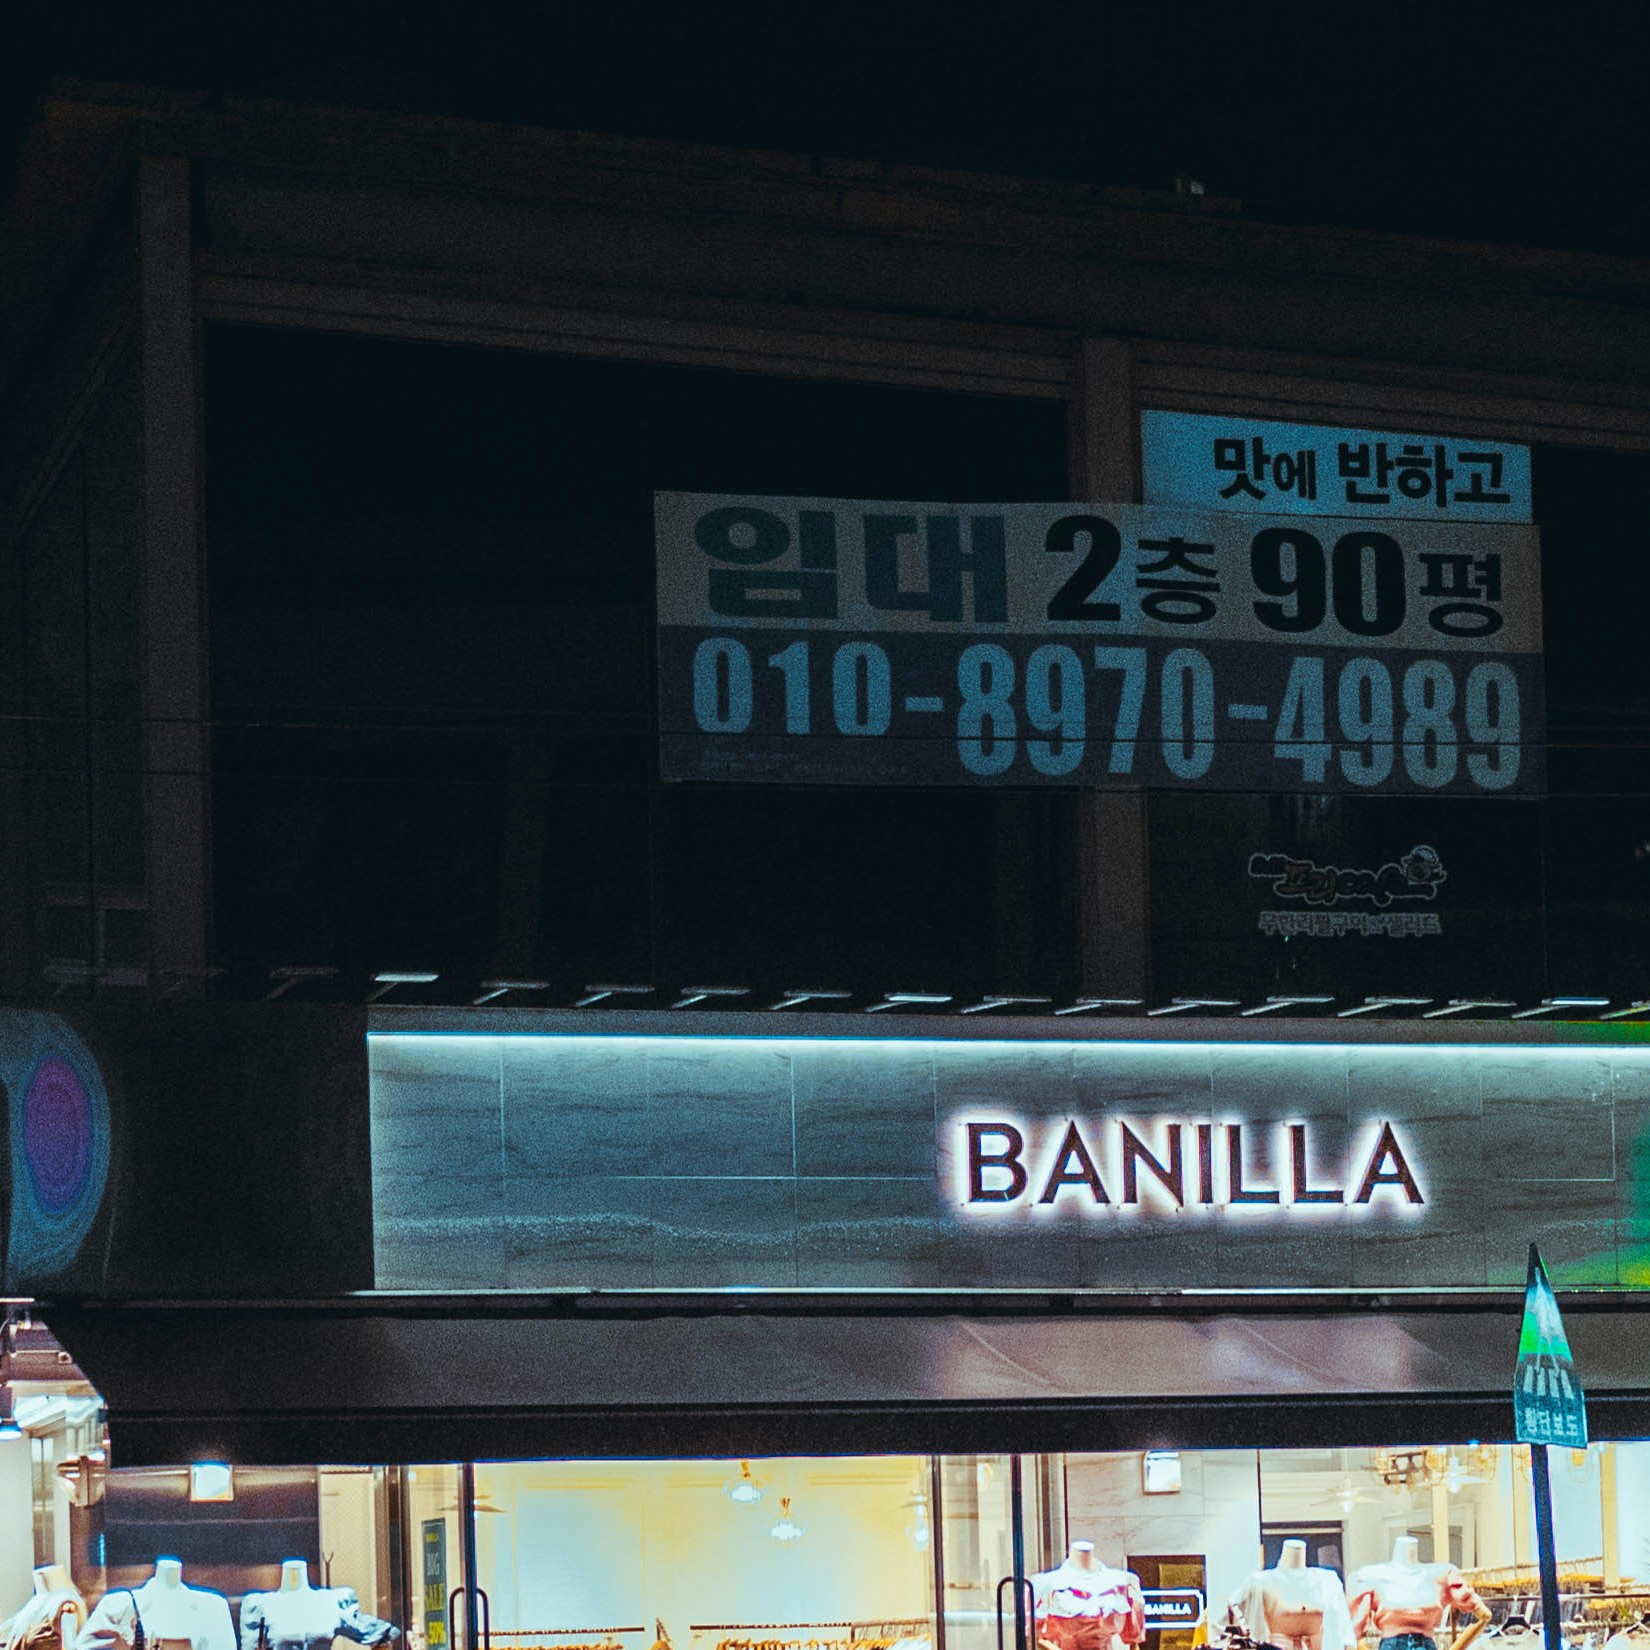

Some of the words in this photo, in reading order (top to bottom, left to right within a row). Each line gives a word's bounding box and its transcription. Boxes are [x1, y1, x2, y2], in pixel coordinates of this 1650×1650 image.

[1213, 436, 1317, 502] 맛에
[1337, 441, 1512, 508] 반하고
[692, 504, 1009, 625] 임대
[1044, 513, 1222, 625] 2층
[1250, 526, 1505, 640] 90평
[691, 636, 1522, 791] 010-8970-4989
[960, 1119, 1426, 1207] BANILLA
